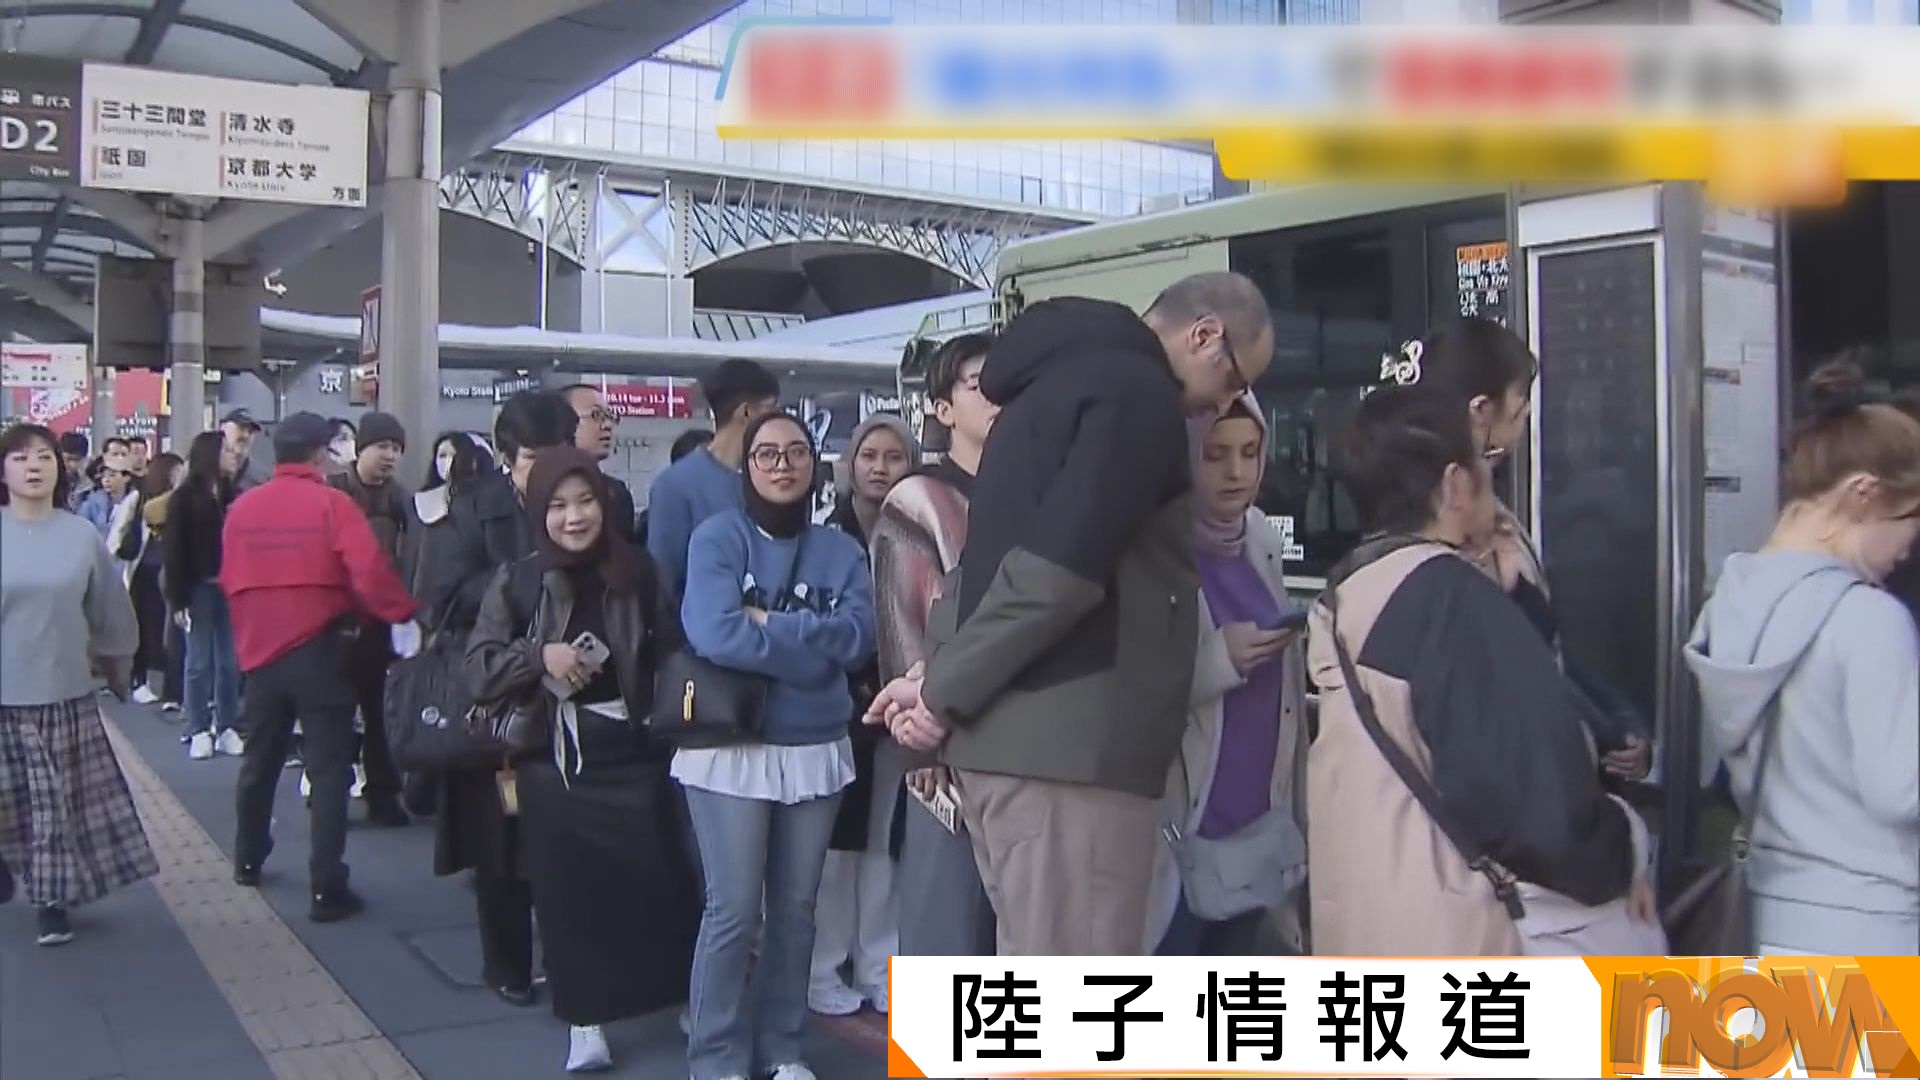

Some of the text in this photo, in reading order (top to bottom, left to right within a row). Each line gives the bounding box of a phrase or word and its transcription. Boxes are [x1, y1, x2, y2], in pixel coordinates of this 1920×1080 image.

[32, 93, 72, 110] 市バス
[101, 100, 206, 127] 三十三間堂
[229, 113, 295, 135] 清水寺
[0, 116, 58, 152] D2
[228, 158, 316, 181] 京都大学
[333, 187, 361, 201] 方面
[321, 369, 344, 392] 京
[443, 385, 469, 397] Kyoto
[471, 386, 493, 396] Stati
